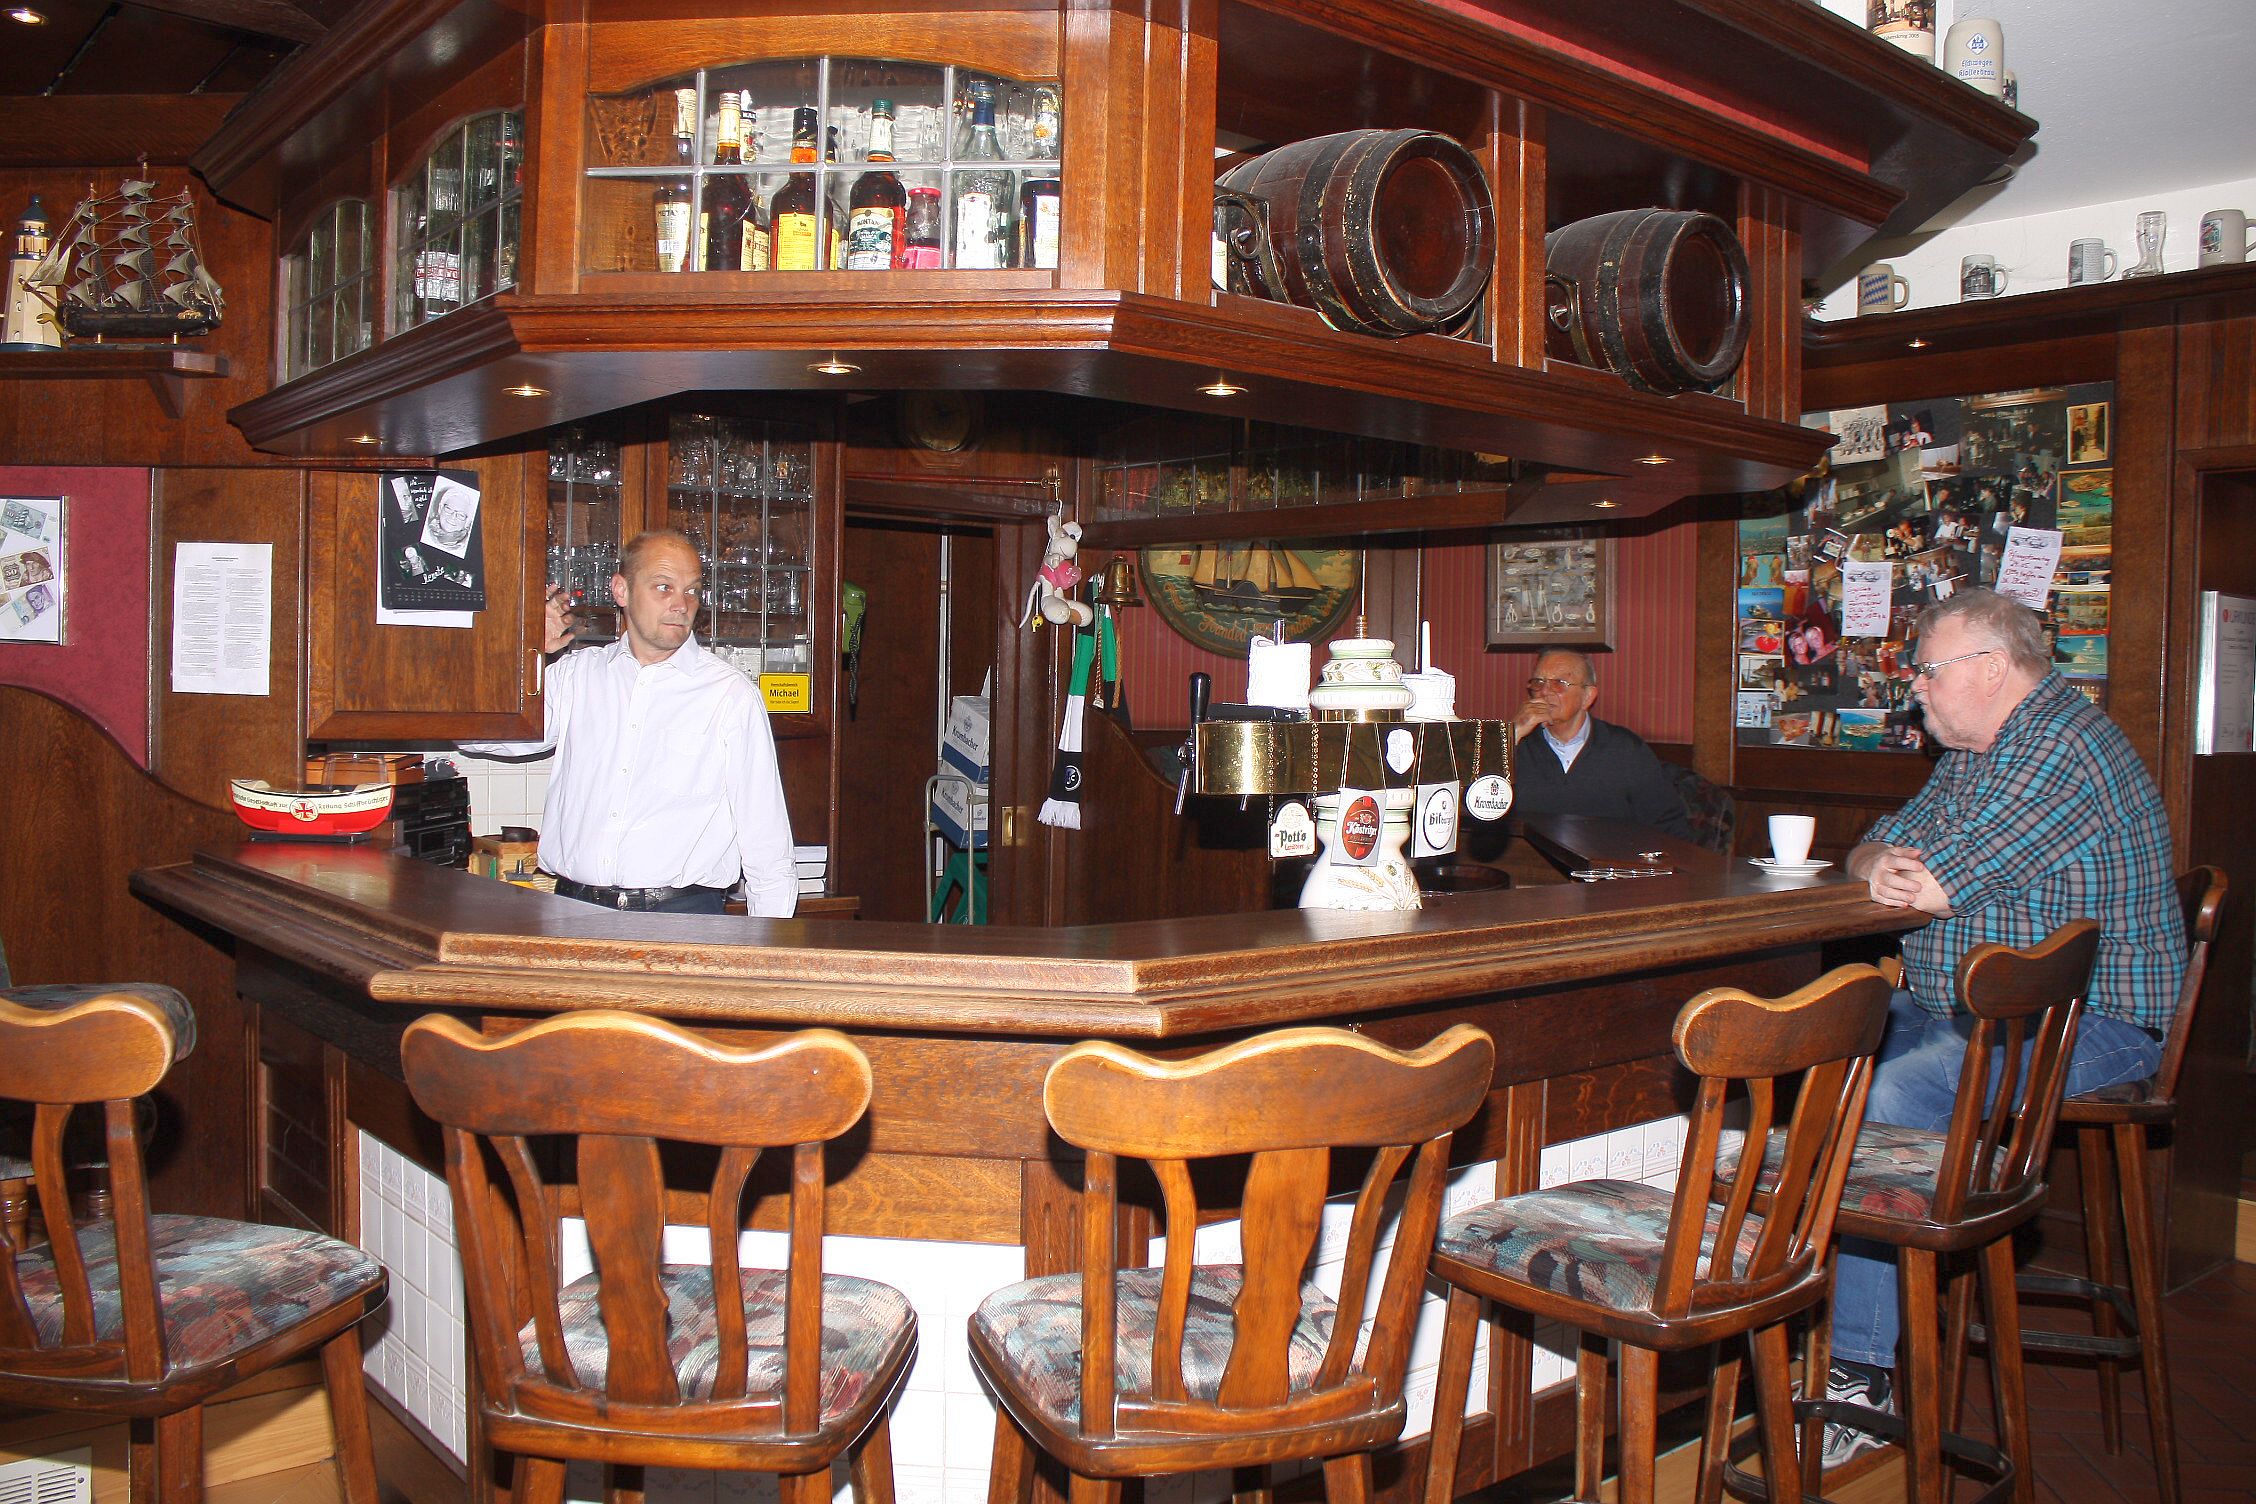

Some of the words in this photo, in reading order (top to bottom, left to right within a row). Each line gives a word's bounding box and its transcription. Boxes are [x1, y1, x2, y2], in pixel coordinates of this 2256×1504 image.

[769, 689, 799, 698] Michael
[952, 725, 979, 751] Krombacher
[1279, 829, 1307, 848] Pott's
